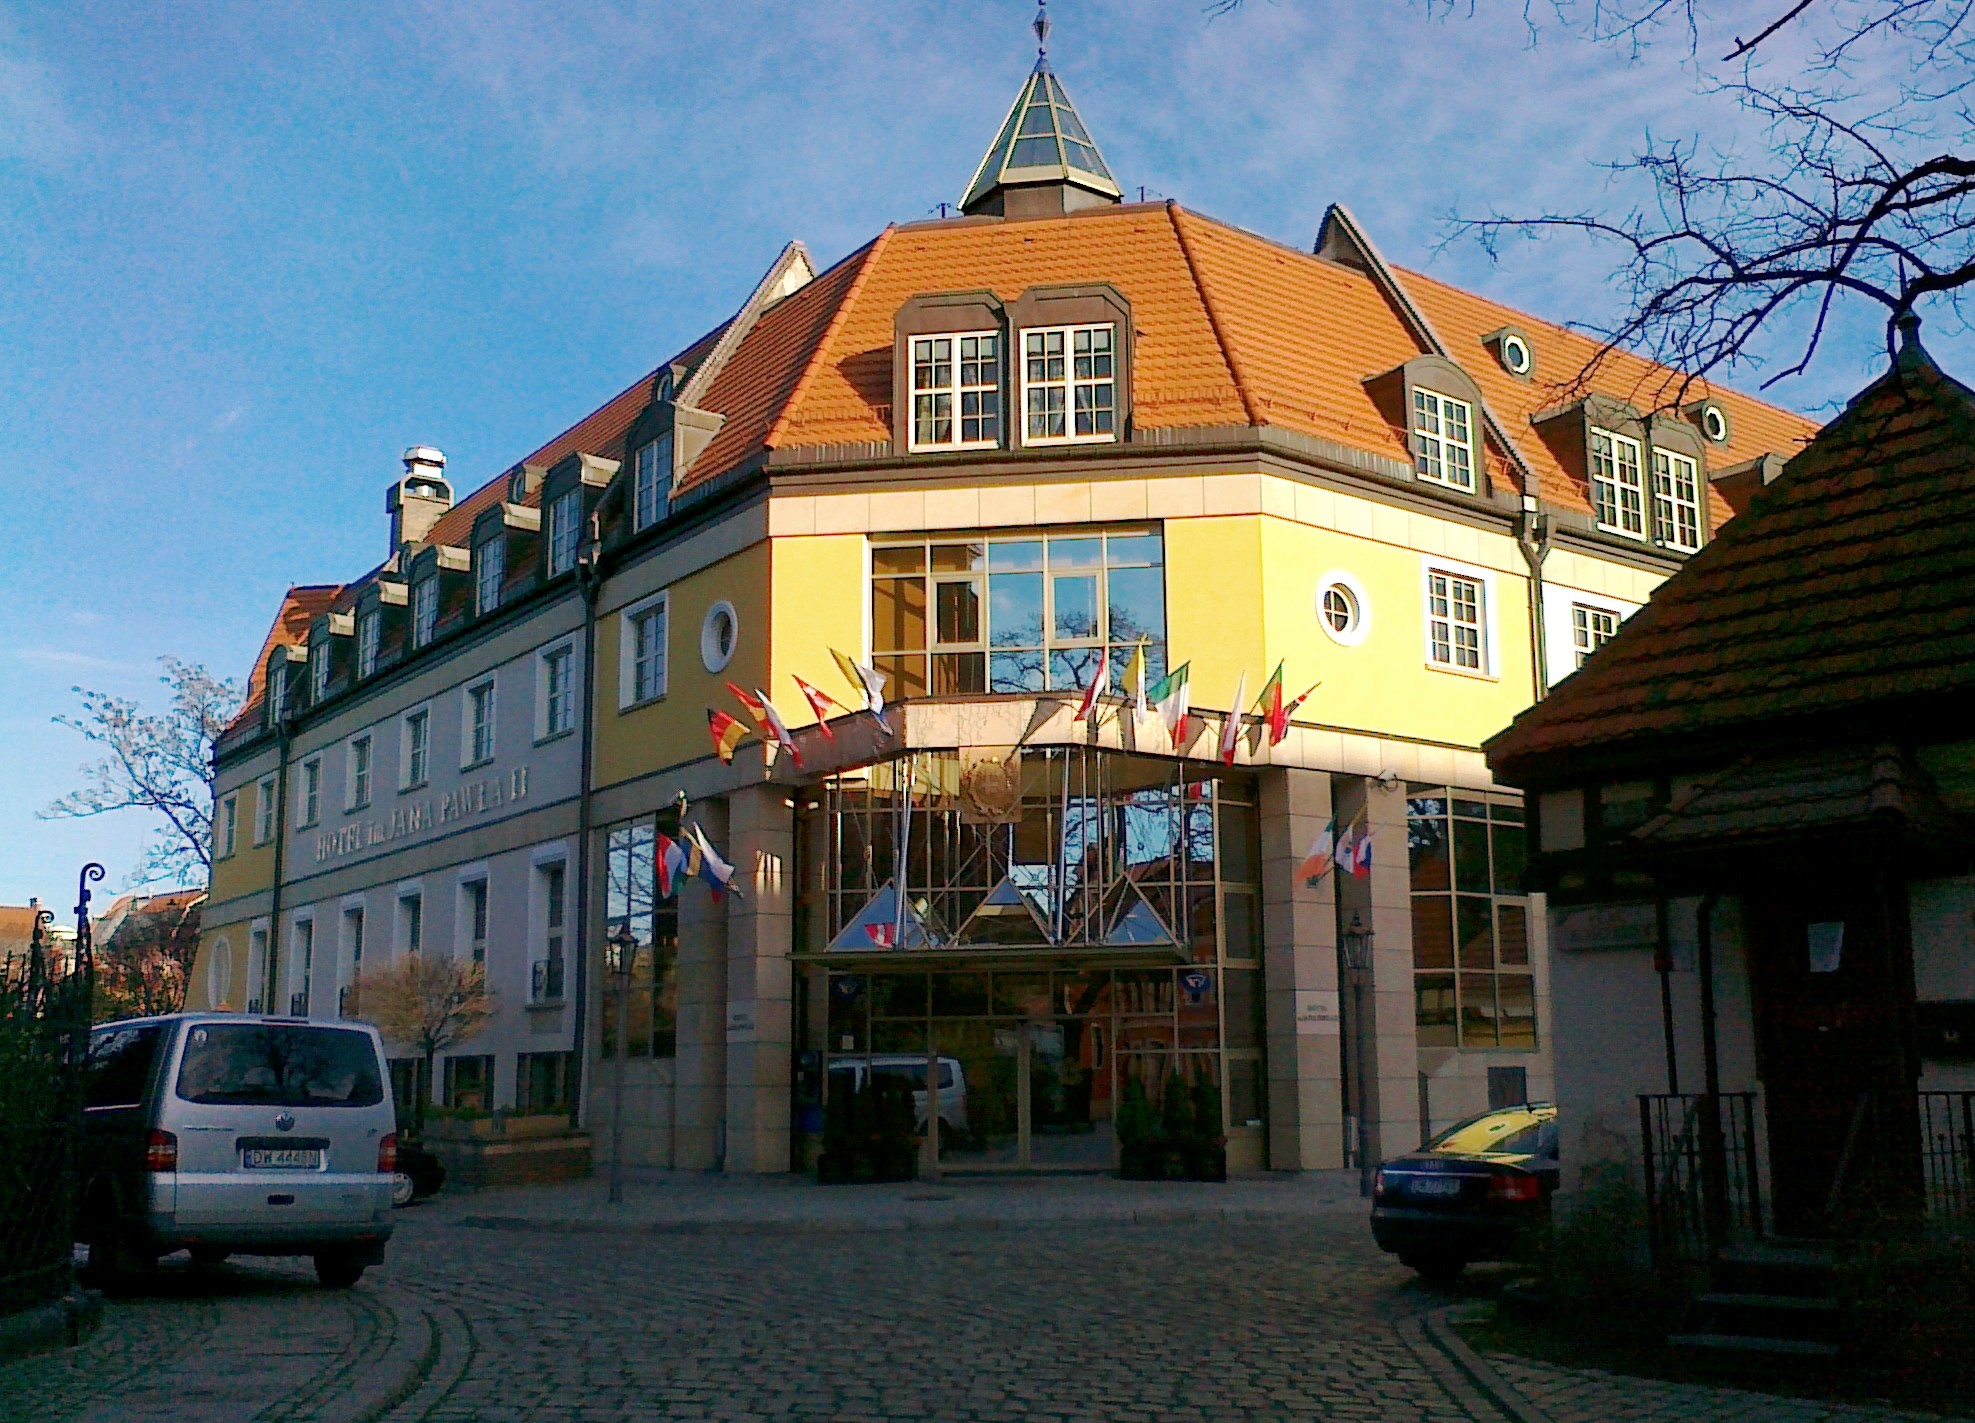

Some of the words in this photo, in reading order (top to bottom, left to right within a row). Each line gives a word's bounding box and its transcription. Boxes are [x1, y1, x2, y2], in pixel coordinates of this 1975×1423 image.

[316, 821, 362, 862] HOTEL
[391, 800, 433, 840] JANA
[510, 765, 529, 801] II
